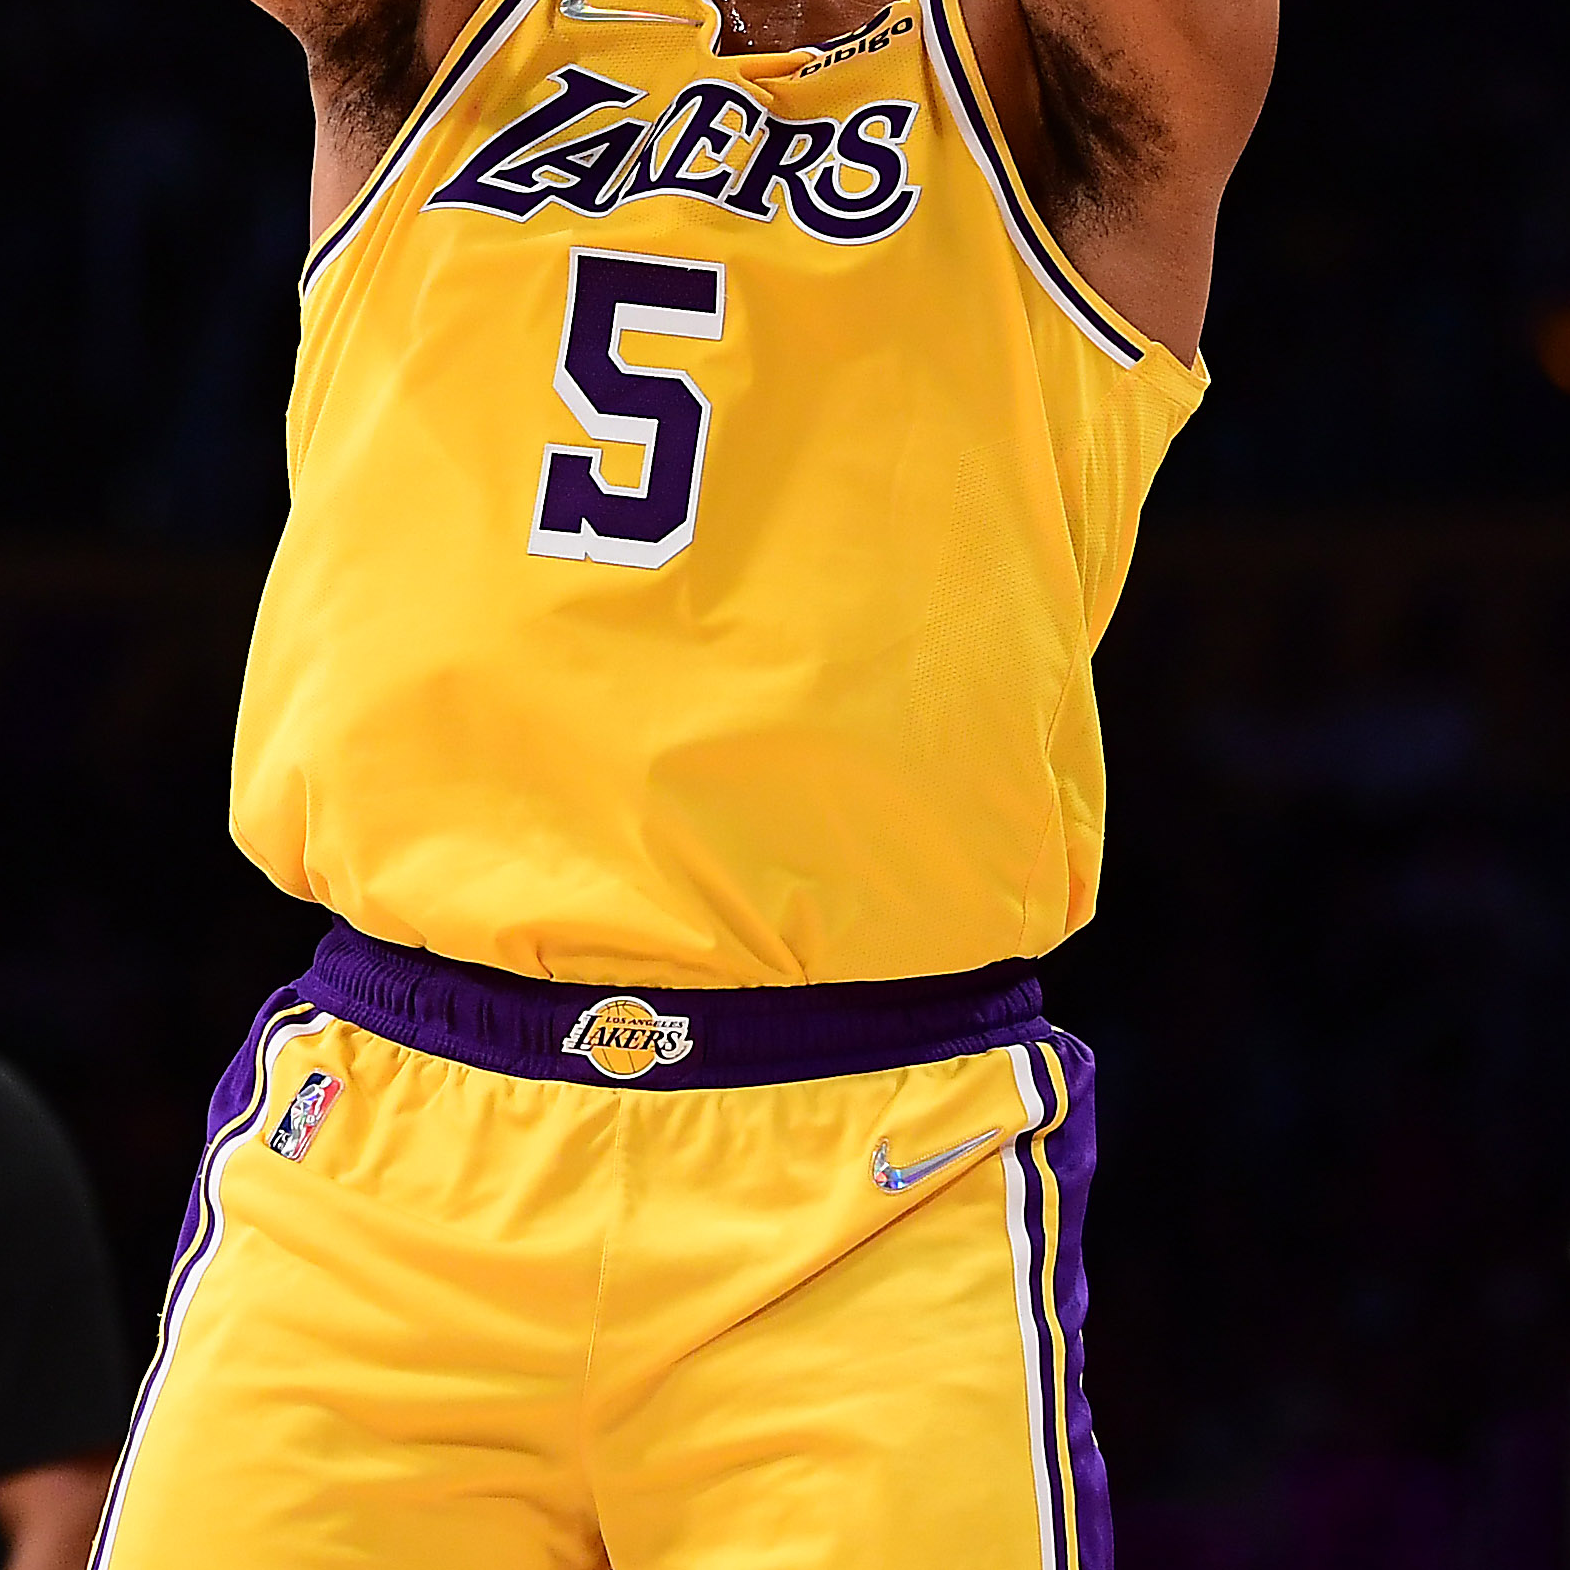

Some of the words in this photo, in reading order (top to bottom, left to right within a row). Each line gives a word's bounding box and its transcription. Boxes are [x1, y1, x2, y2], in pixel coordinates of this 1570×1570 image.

[527, 246, 726, 570] 5
[567, 1014, 688, 1060] LAKERS
[605, 1016, 627, 1024] LOS
[627, 1018, 684, 1029] ANGELES
